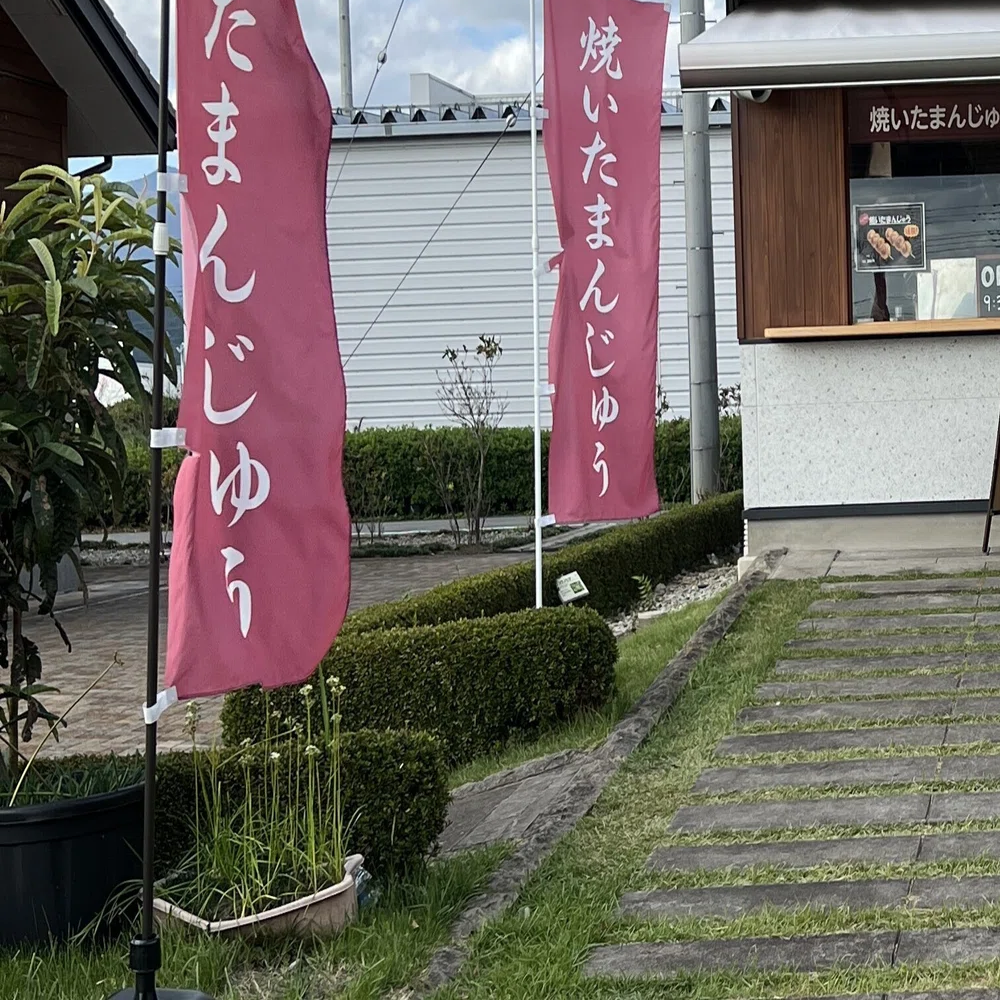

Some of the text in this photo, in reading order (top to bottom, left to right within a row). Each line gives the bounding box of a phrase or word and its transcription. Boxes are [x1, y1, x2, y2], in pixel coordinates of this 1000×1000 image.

[579, 15, 623, 499] 焼いたまんじゅう
